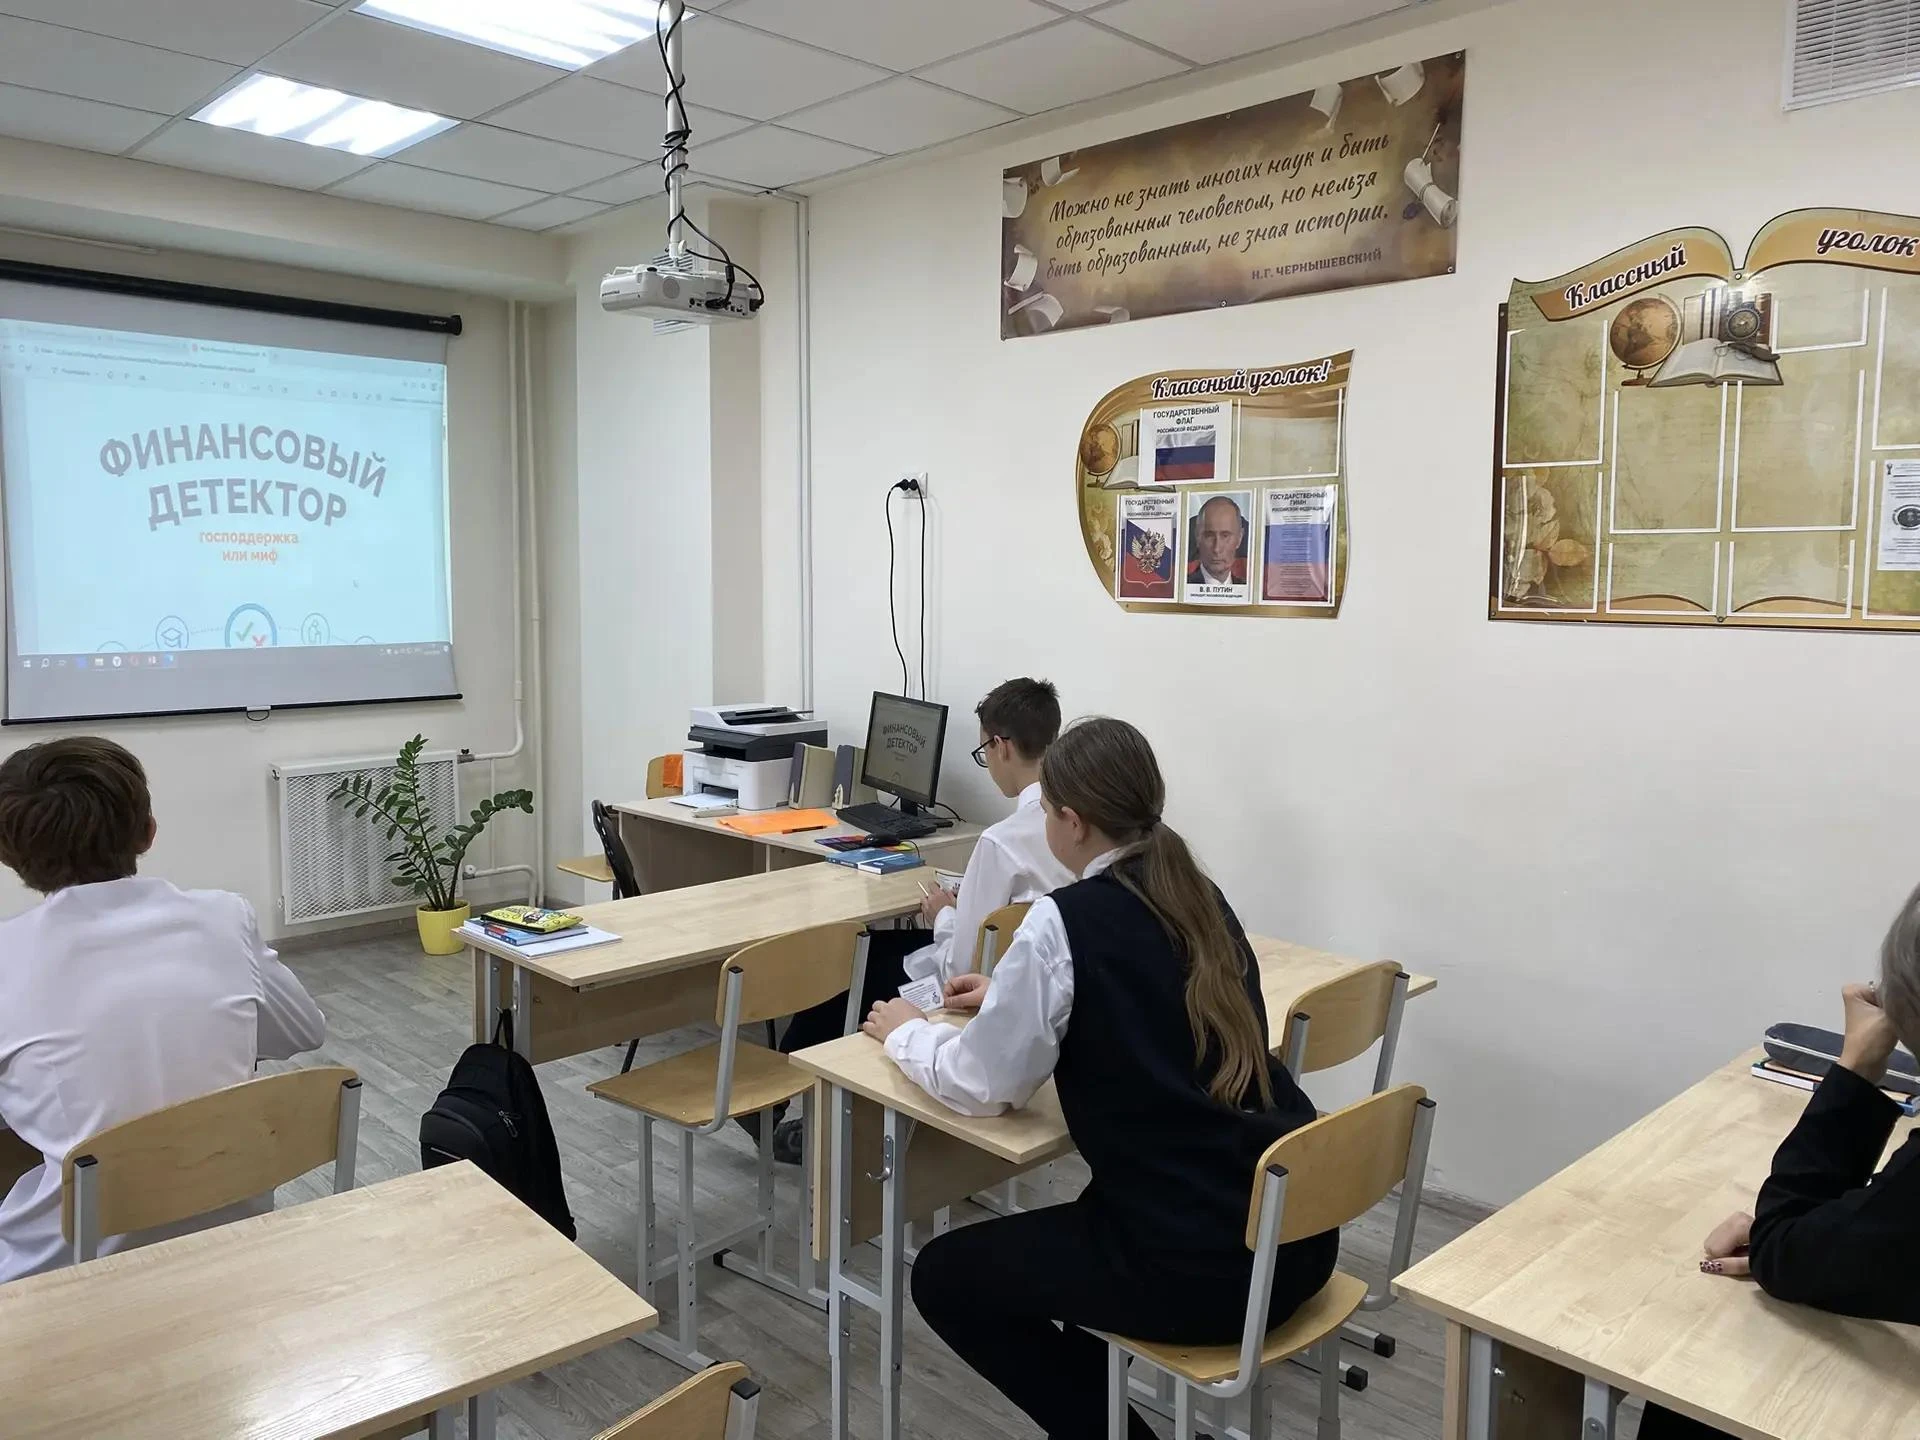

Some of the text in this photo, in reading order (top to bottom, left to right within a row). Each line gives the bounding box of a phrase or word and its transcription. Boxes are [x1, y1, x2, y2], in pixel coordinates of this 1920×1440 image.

[1049, 132, 1390, 223] Можно не знать многих наук и быть
[1056, 171, 1378, 253] образованным человеком, но нельзя
[1046, 204, 1388, 280] быть образованным, не зная истории.
[1251, 248, 1382, 280] Н.Г. ЧЕРНЫШЕВСКИЙ
[1566, 229, 1919, 310] Классный уголок
[1151, 360, 1331, 399] Классный уголок!
[1153, 405, 1220, 418] ГОСУДАРСТВЕННЫЙ
[1176, 417, 1194, 425] ФЛАГ
[100, 423, 387, 498] ФИНАНСОВЫЙ
[148, 478, 347, 531] ДЕТЕКТОР
[199, 532, 299, 546] господдержка
[223, 548, 278, 565] или миф
[882, 723, 927, 748] ФИНАНСОВЫЙ
[886, 737, 918, 754] ДЕТЕКТОР
